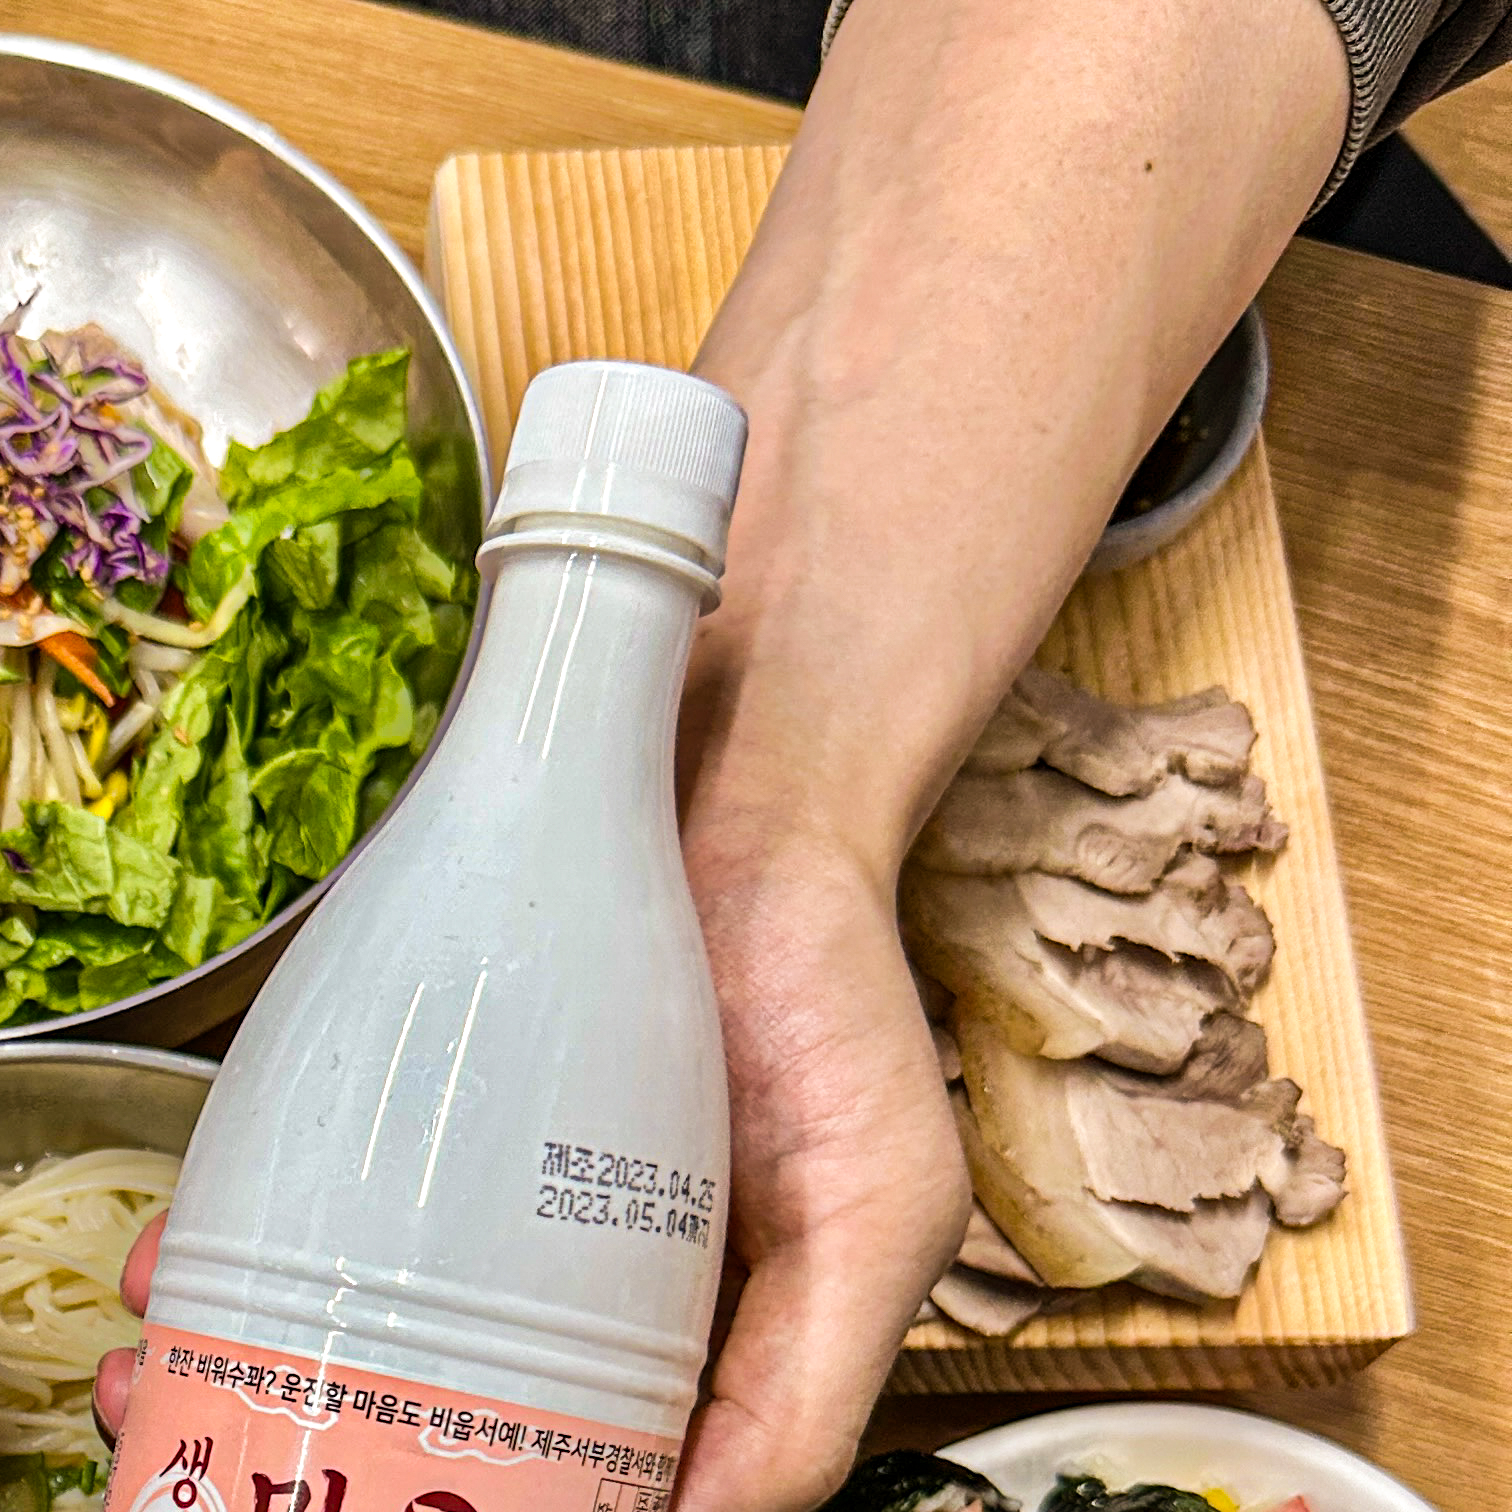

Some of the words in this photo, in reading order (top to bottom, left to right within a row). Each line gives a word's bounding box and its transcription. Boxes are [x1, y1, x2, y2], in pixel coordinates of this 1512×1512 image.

[167, 1346, 194, 1377] 한잔
[196, 1354, 276, 1394] 비워수꽈?
[281, 1373, 347, 1413] 운전할
[353, 1390, 422, 1427] 마음도
[430, 1406, 527, 1452] 비웁서예!
[531, 1429, 656, 1480] 제주서부경찰서와
